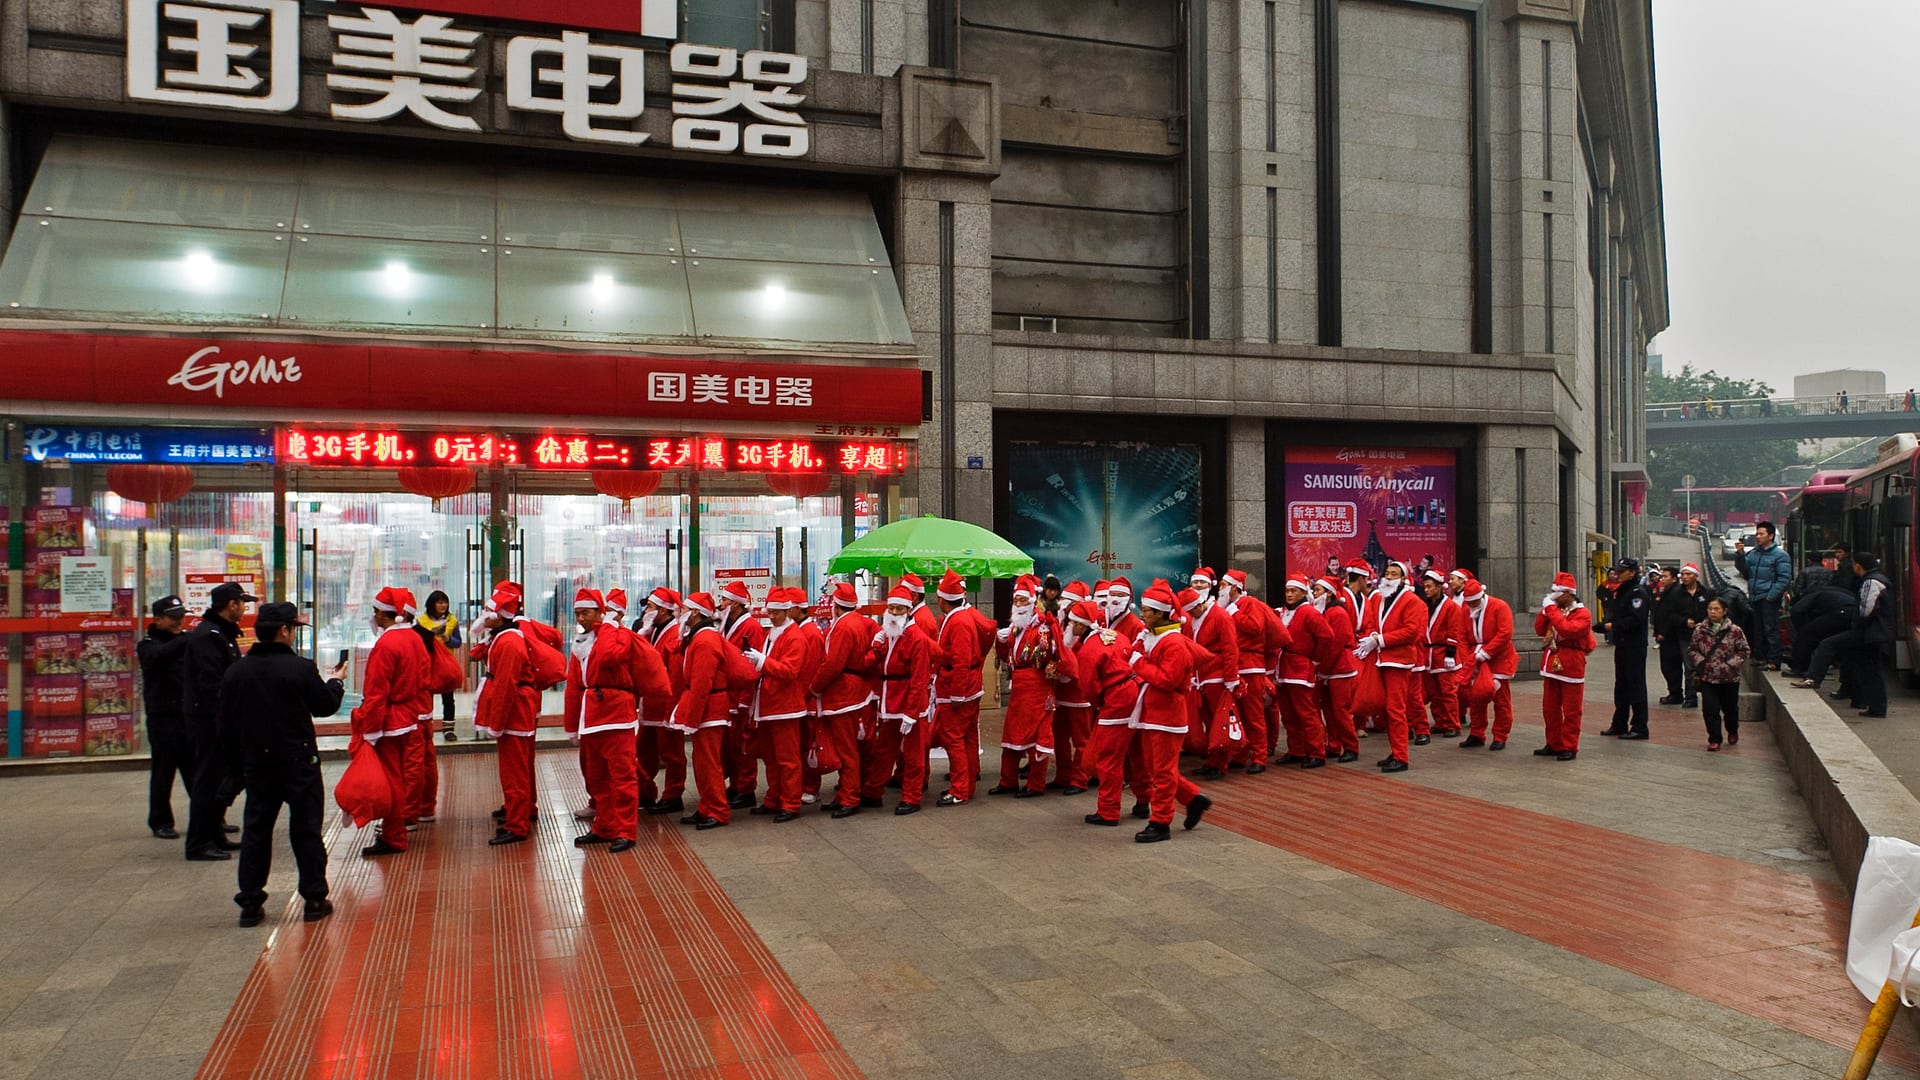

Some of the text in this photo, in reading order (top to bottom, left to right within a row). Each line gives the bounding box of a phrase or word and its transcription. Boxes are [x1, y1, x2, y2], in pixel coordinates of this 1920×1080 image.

[127, 0, 809, 157] 国美电器
[647, 371, 813, 407] 国美电器
[814, 424, 900, 437] 王府井店
[64, 432, 142, 449] 中国电信
[65, 451, 97, 460] CHINA
[1303, 474, 1435, 493] SAMSUNG Anycall
[1293, 506, 1347, 519] 新年聚群星
[1298, 520, 1352, 533] 聚星欢乐送
